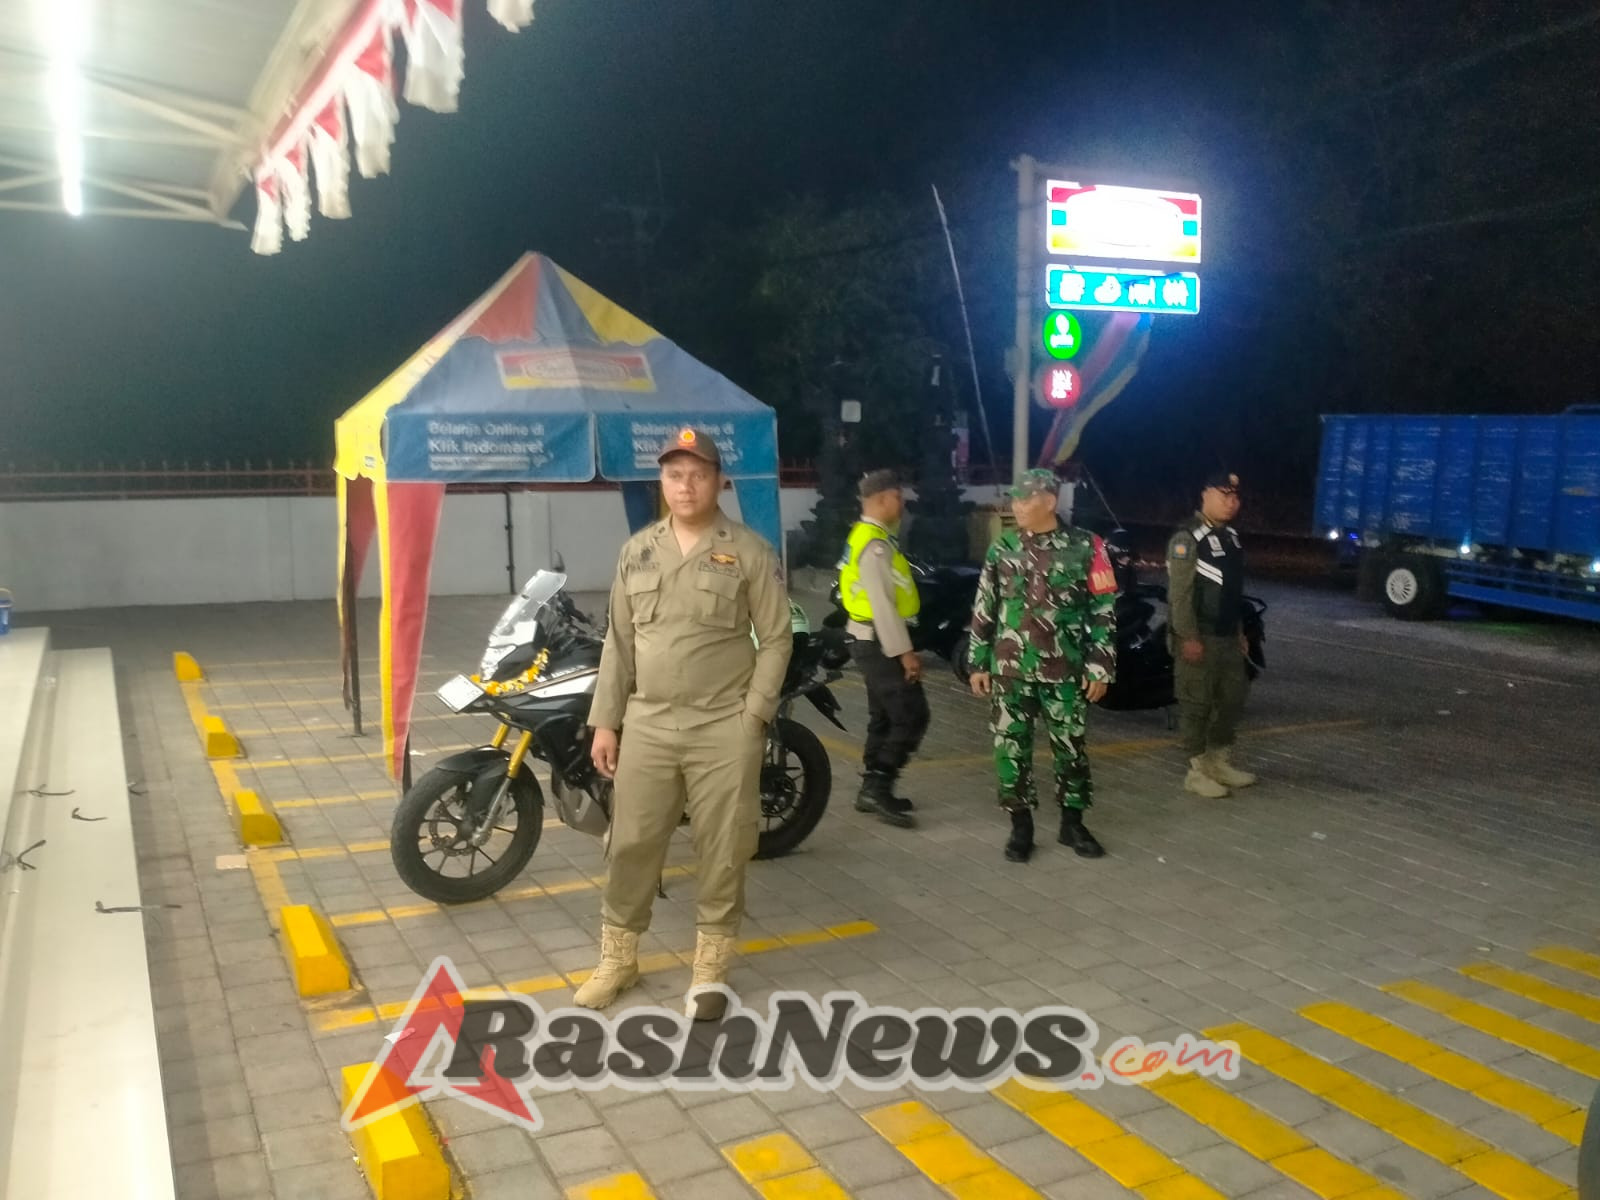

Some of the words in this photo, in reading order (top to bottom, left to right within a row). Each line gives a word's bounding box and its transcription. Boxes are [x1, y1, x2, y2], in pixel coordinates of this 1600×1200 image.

[429, 421, 480, 437] Belanja
[485, 422, 529, 436] Online
[531, 423, 545, 436] di
[429, 440, 460, 453] Klik
[463, 440, 545, 454] Indomaret
